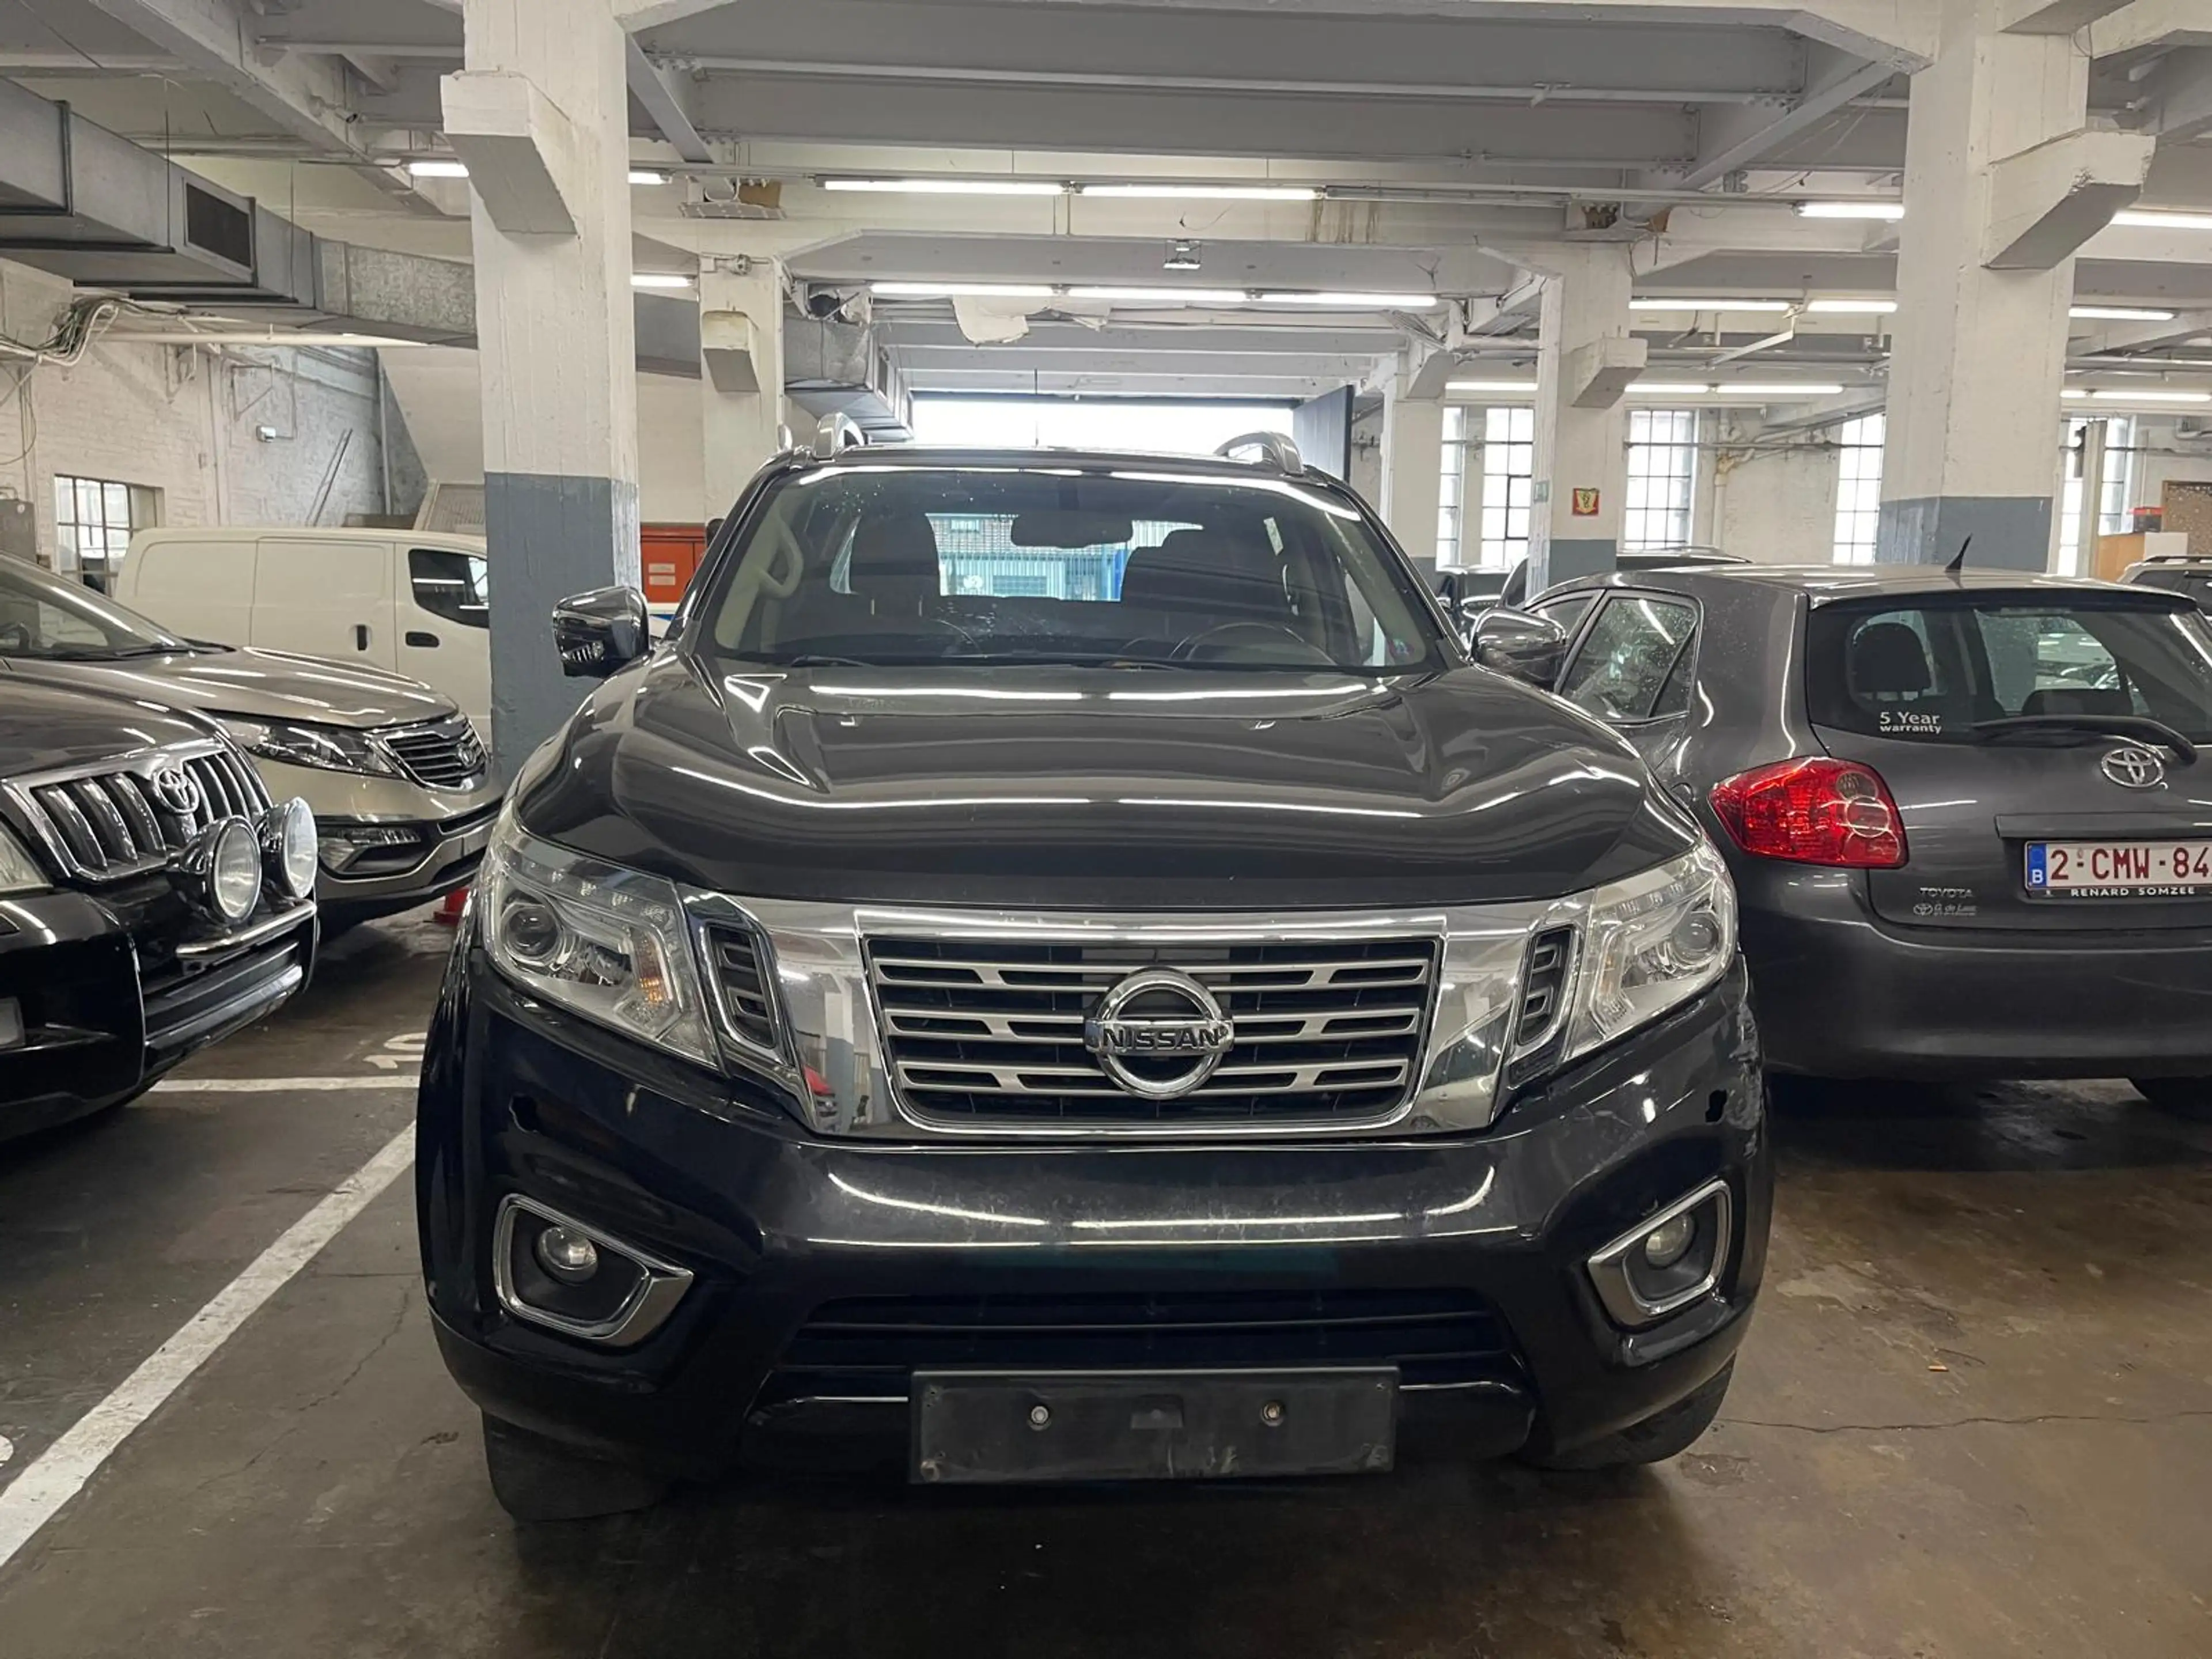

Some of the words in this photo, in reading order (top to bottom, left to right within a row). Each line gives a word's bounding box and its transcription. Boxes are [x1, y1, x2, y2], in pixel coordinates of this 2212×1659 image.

[1880, 711, 1891, 725] 5
[1897, 711, 1941, 725] Year
[1880, 725, 1942, 734] warranty
[2032, 869, 2044, 884] B
[1919, 887, 1974, 899] TOYOTA
[2071, 888, 2129, 896] RENARD
[2138, 886, 2195, 895] SOMZEE
[1102, 1028, 1222, 1051] NISSAN
